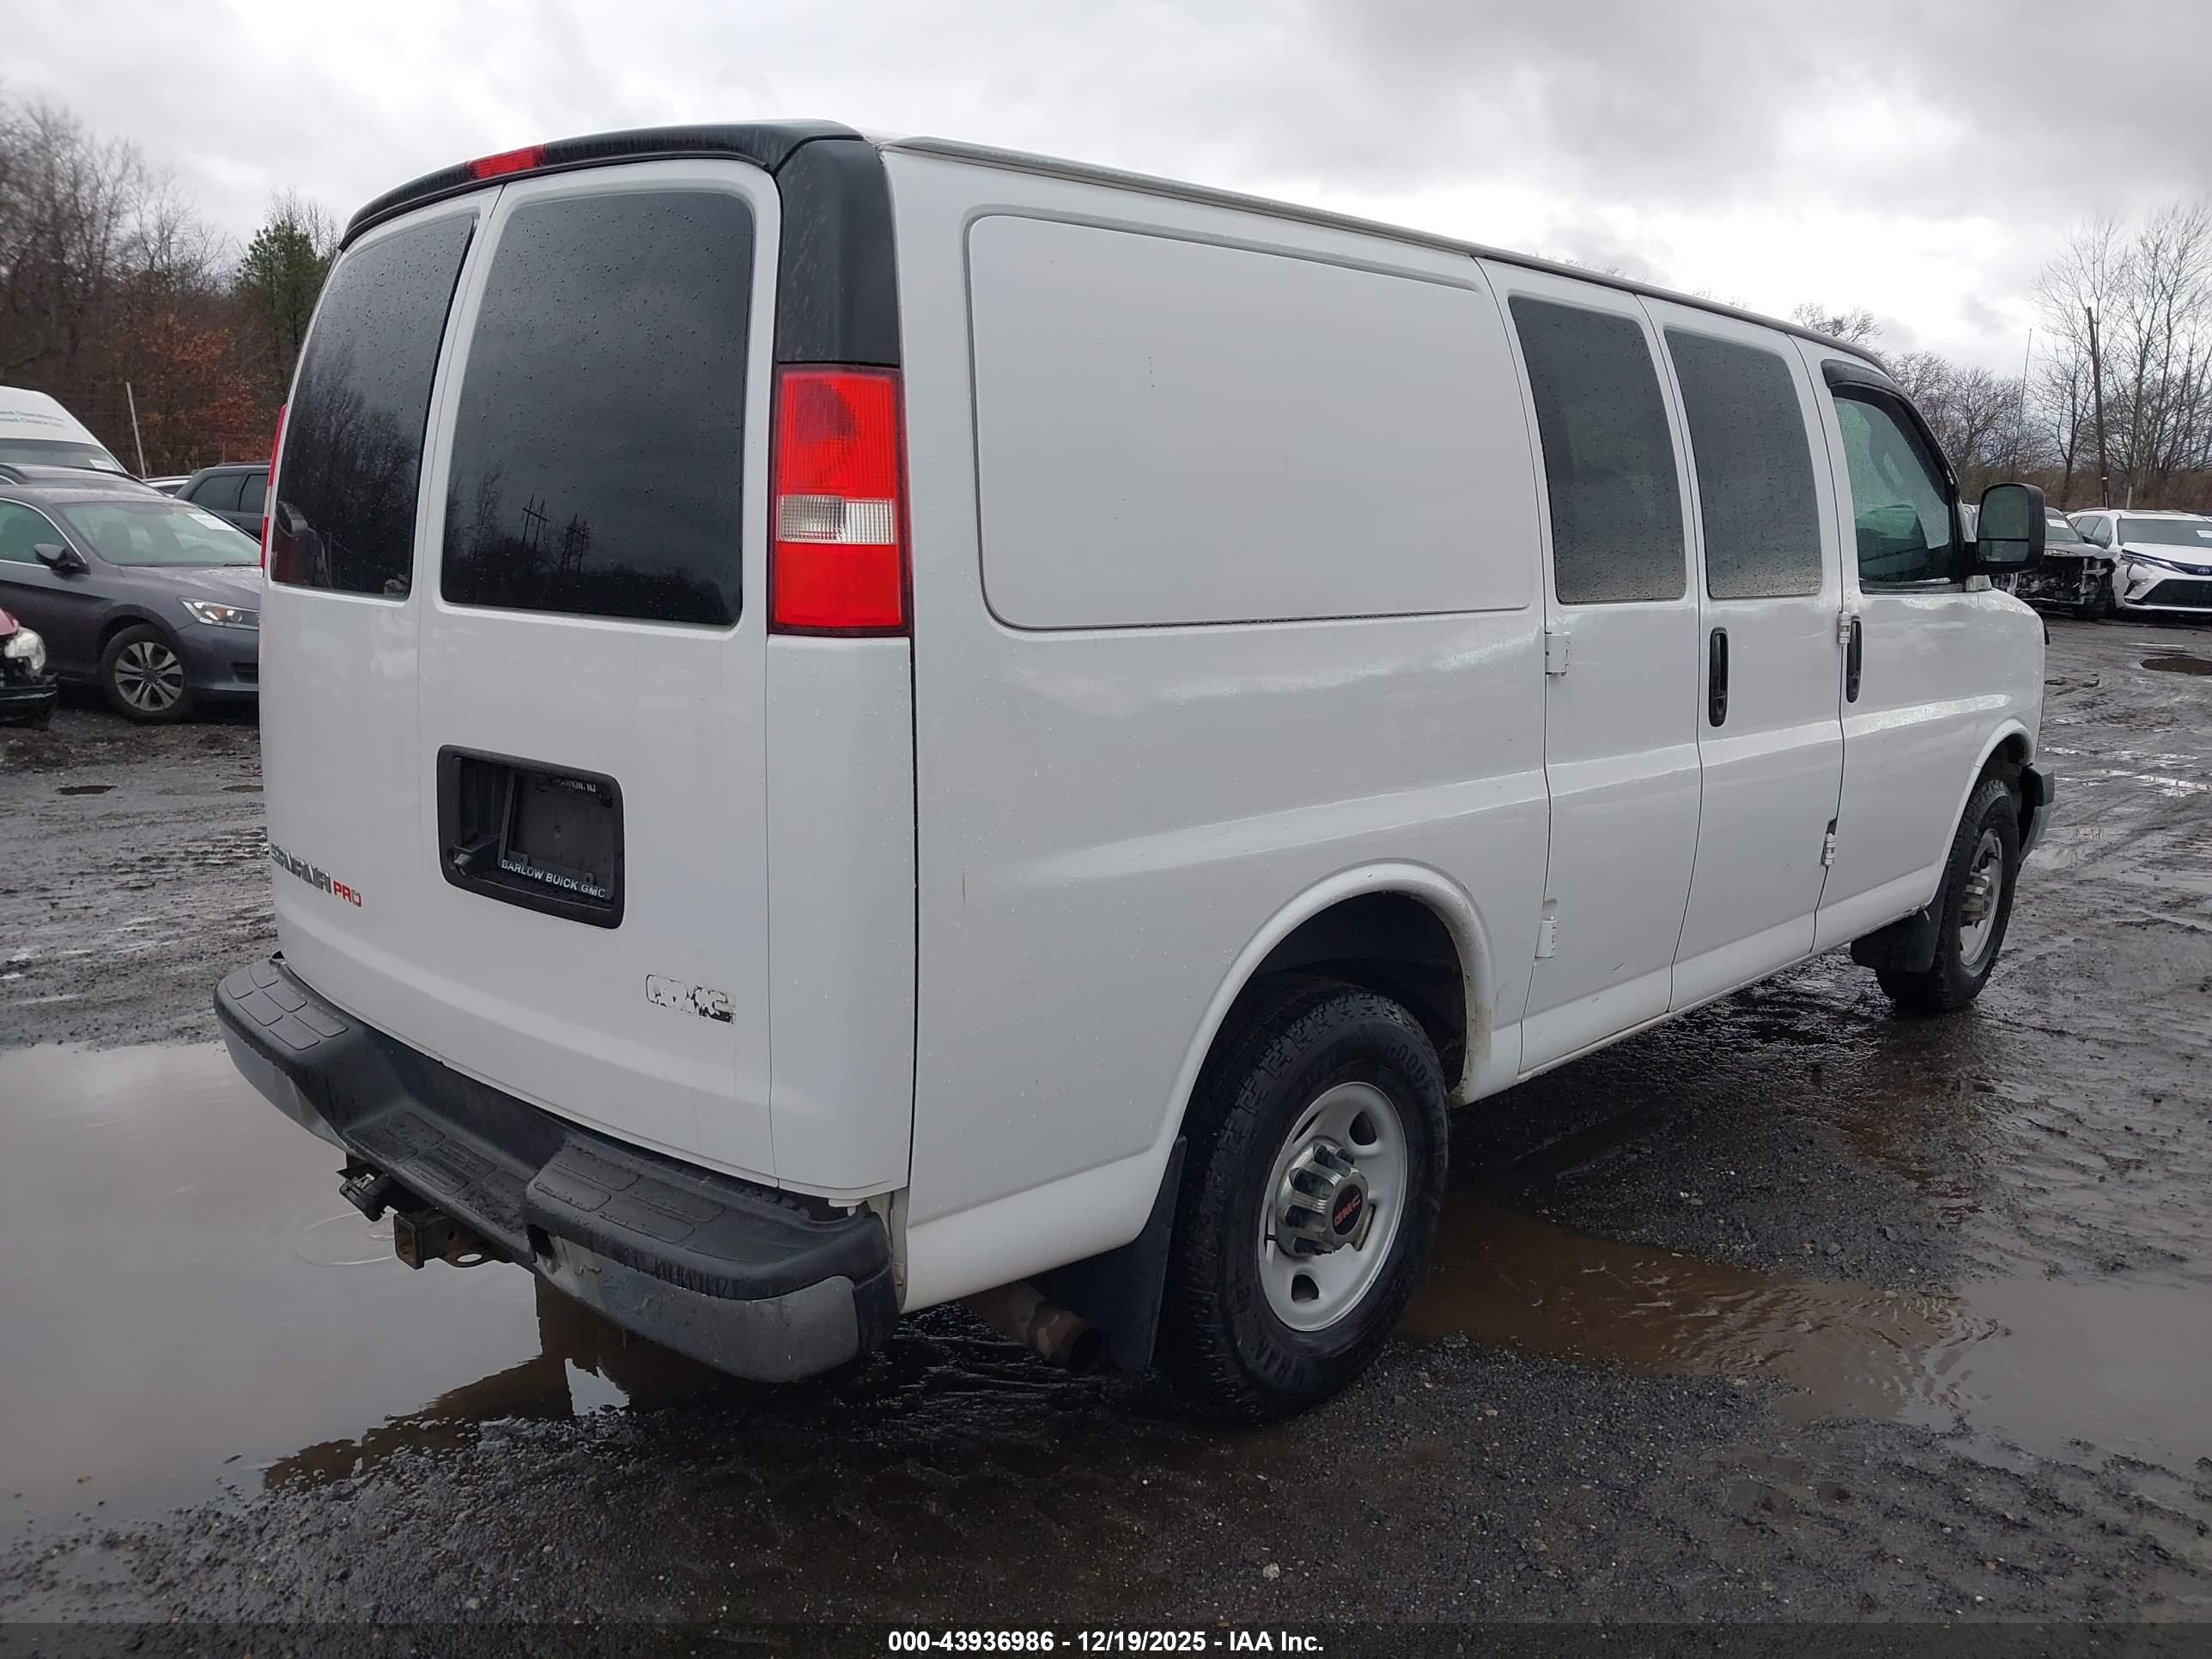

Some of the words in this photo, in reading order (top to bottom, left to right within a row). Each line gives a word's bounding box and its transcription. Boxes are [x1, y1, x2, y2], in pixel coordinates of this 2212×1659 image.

[333, 880, 362, 908] PRO
[501, 860, 544, 880] BARLOW
[545, 872, 580, 890] BUICK
[580, 883, 606, 898] GMC
[1334, 1193, 1361, 1227] GMC
